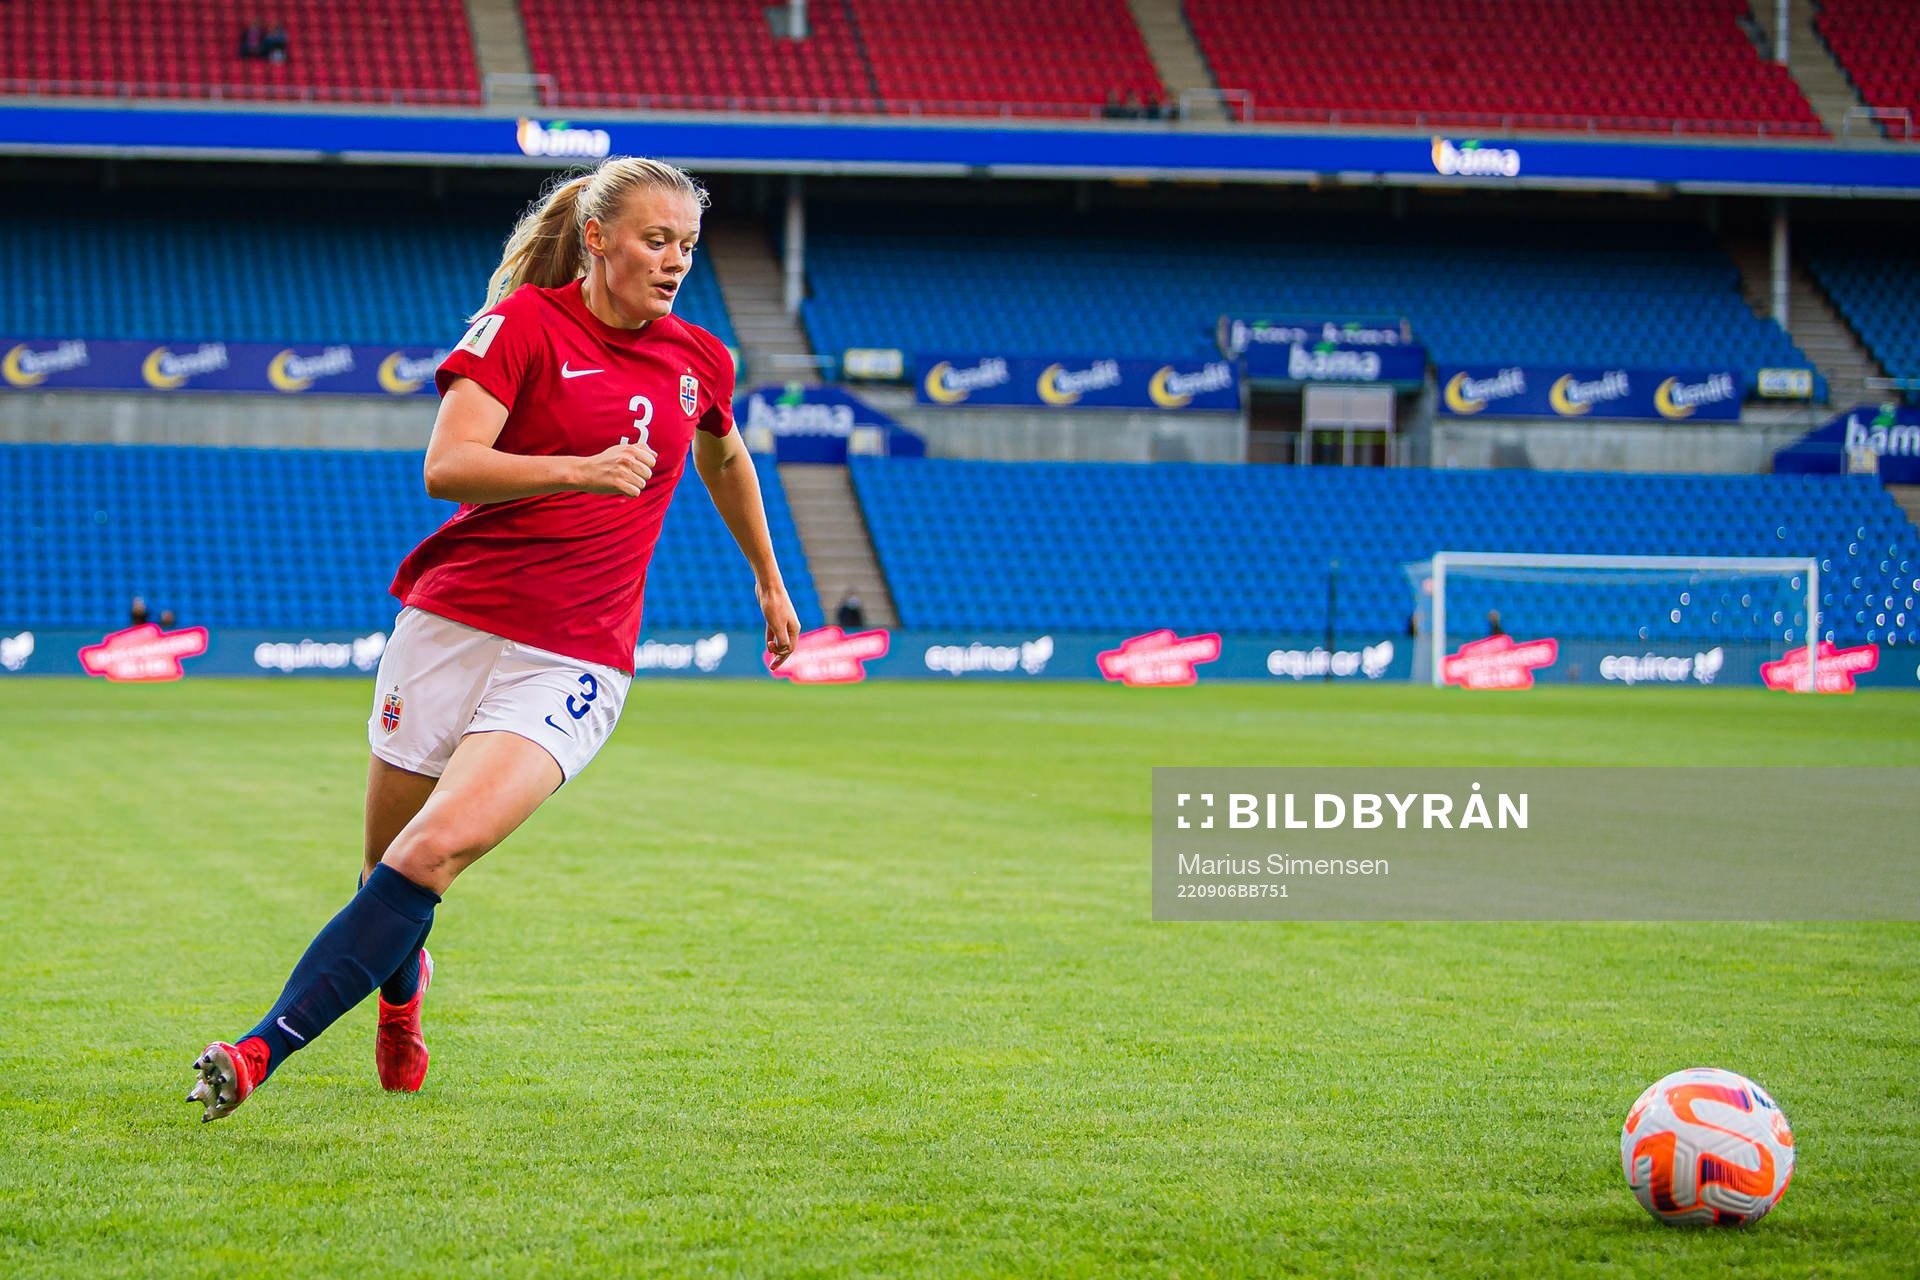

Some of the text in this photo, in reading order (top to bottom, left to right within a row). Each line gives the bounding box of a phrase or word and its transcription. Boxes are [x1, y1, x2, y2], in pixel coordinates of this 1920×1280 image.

[620, 395, 653, 445] 3
[1845, 414, 1920, 456] bam
[566, 673, 598, 720] 3
